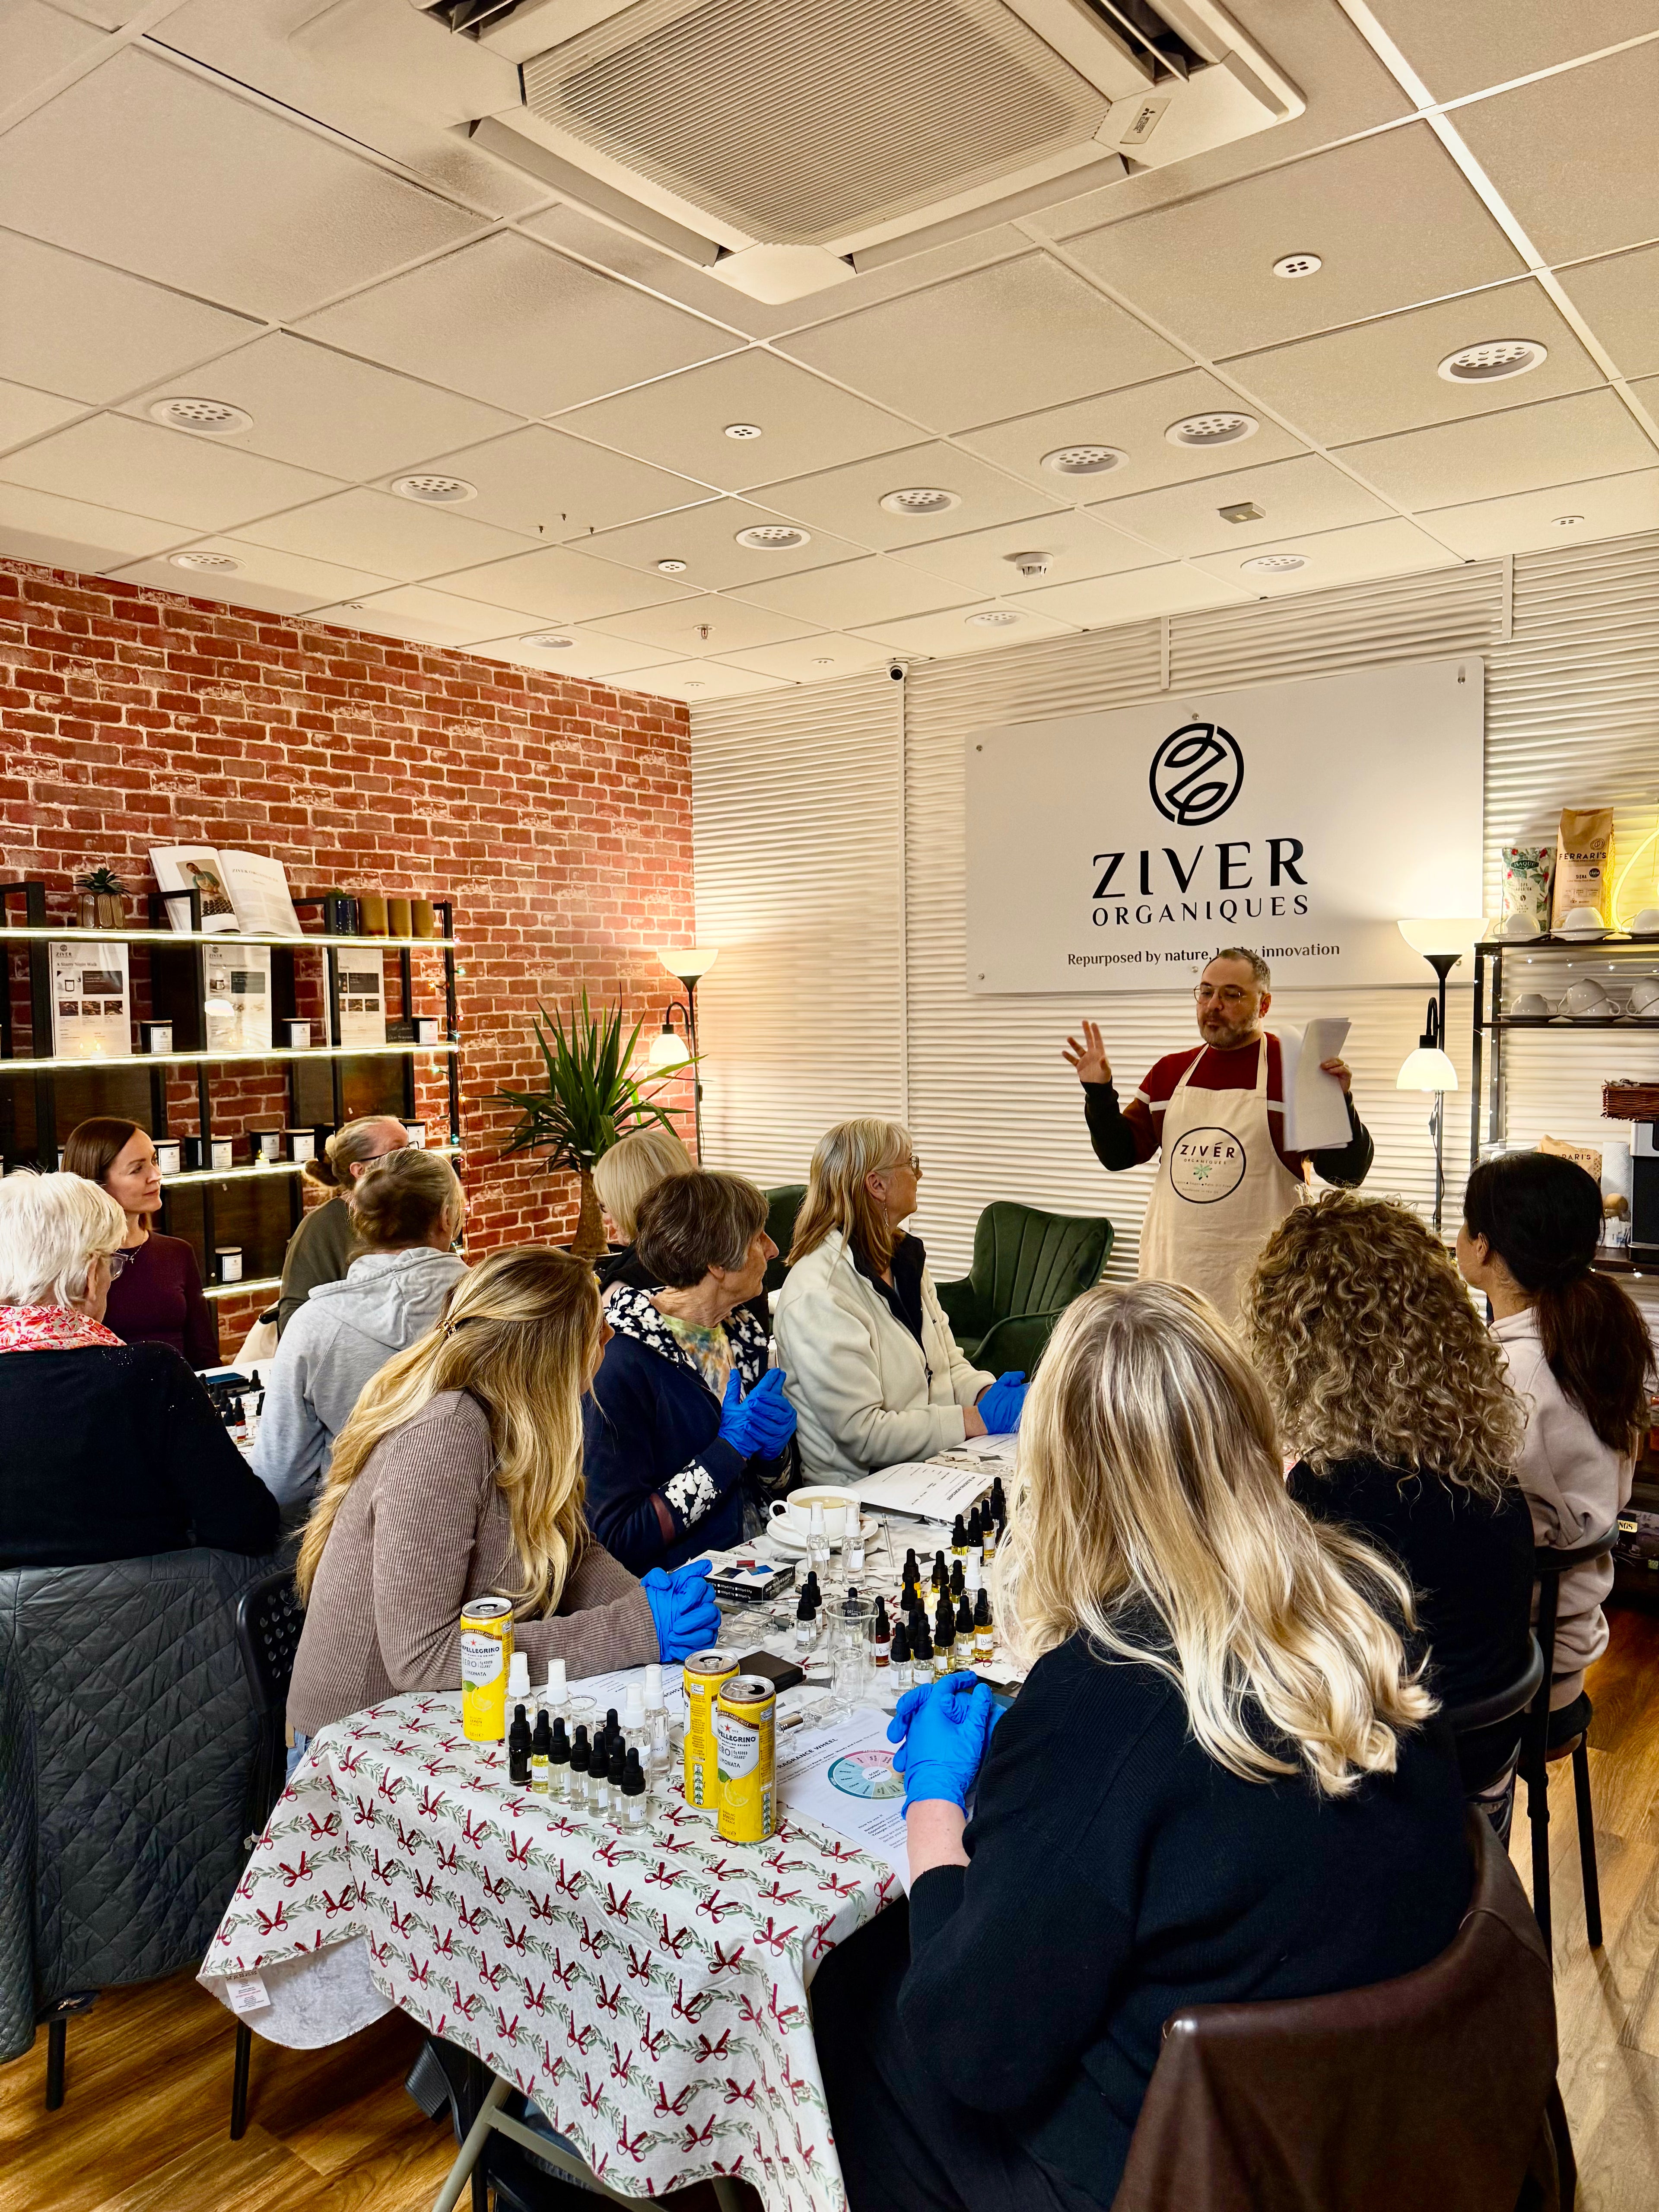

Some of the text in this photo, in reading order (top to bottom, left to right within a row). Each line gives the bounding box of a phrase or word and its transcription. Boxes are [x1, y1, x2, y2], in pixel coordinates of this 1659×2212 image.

[1559, 852, 1607, 860] FERRARI'S
[1092, 838, 1308, 899] ZIVER
[1092, 895, 1308, 927] ORGANIQUES
[1067, 951, 1142, 967] Repurposed
[1145, 951, 1161, 965] by
[1165, 950, 1212, 961] nature,
[1262, 944, 1340, 957] innovation
[1180, 1142, 1235, 1158] ZIVÉR
[719, 1756, 741, 1768] LIMONATA
[776, 1738, 838, 1769] RAGRANCE WHEEL
